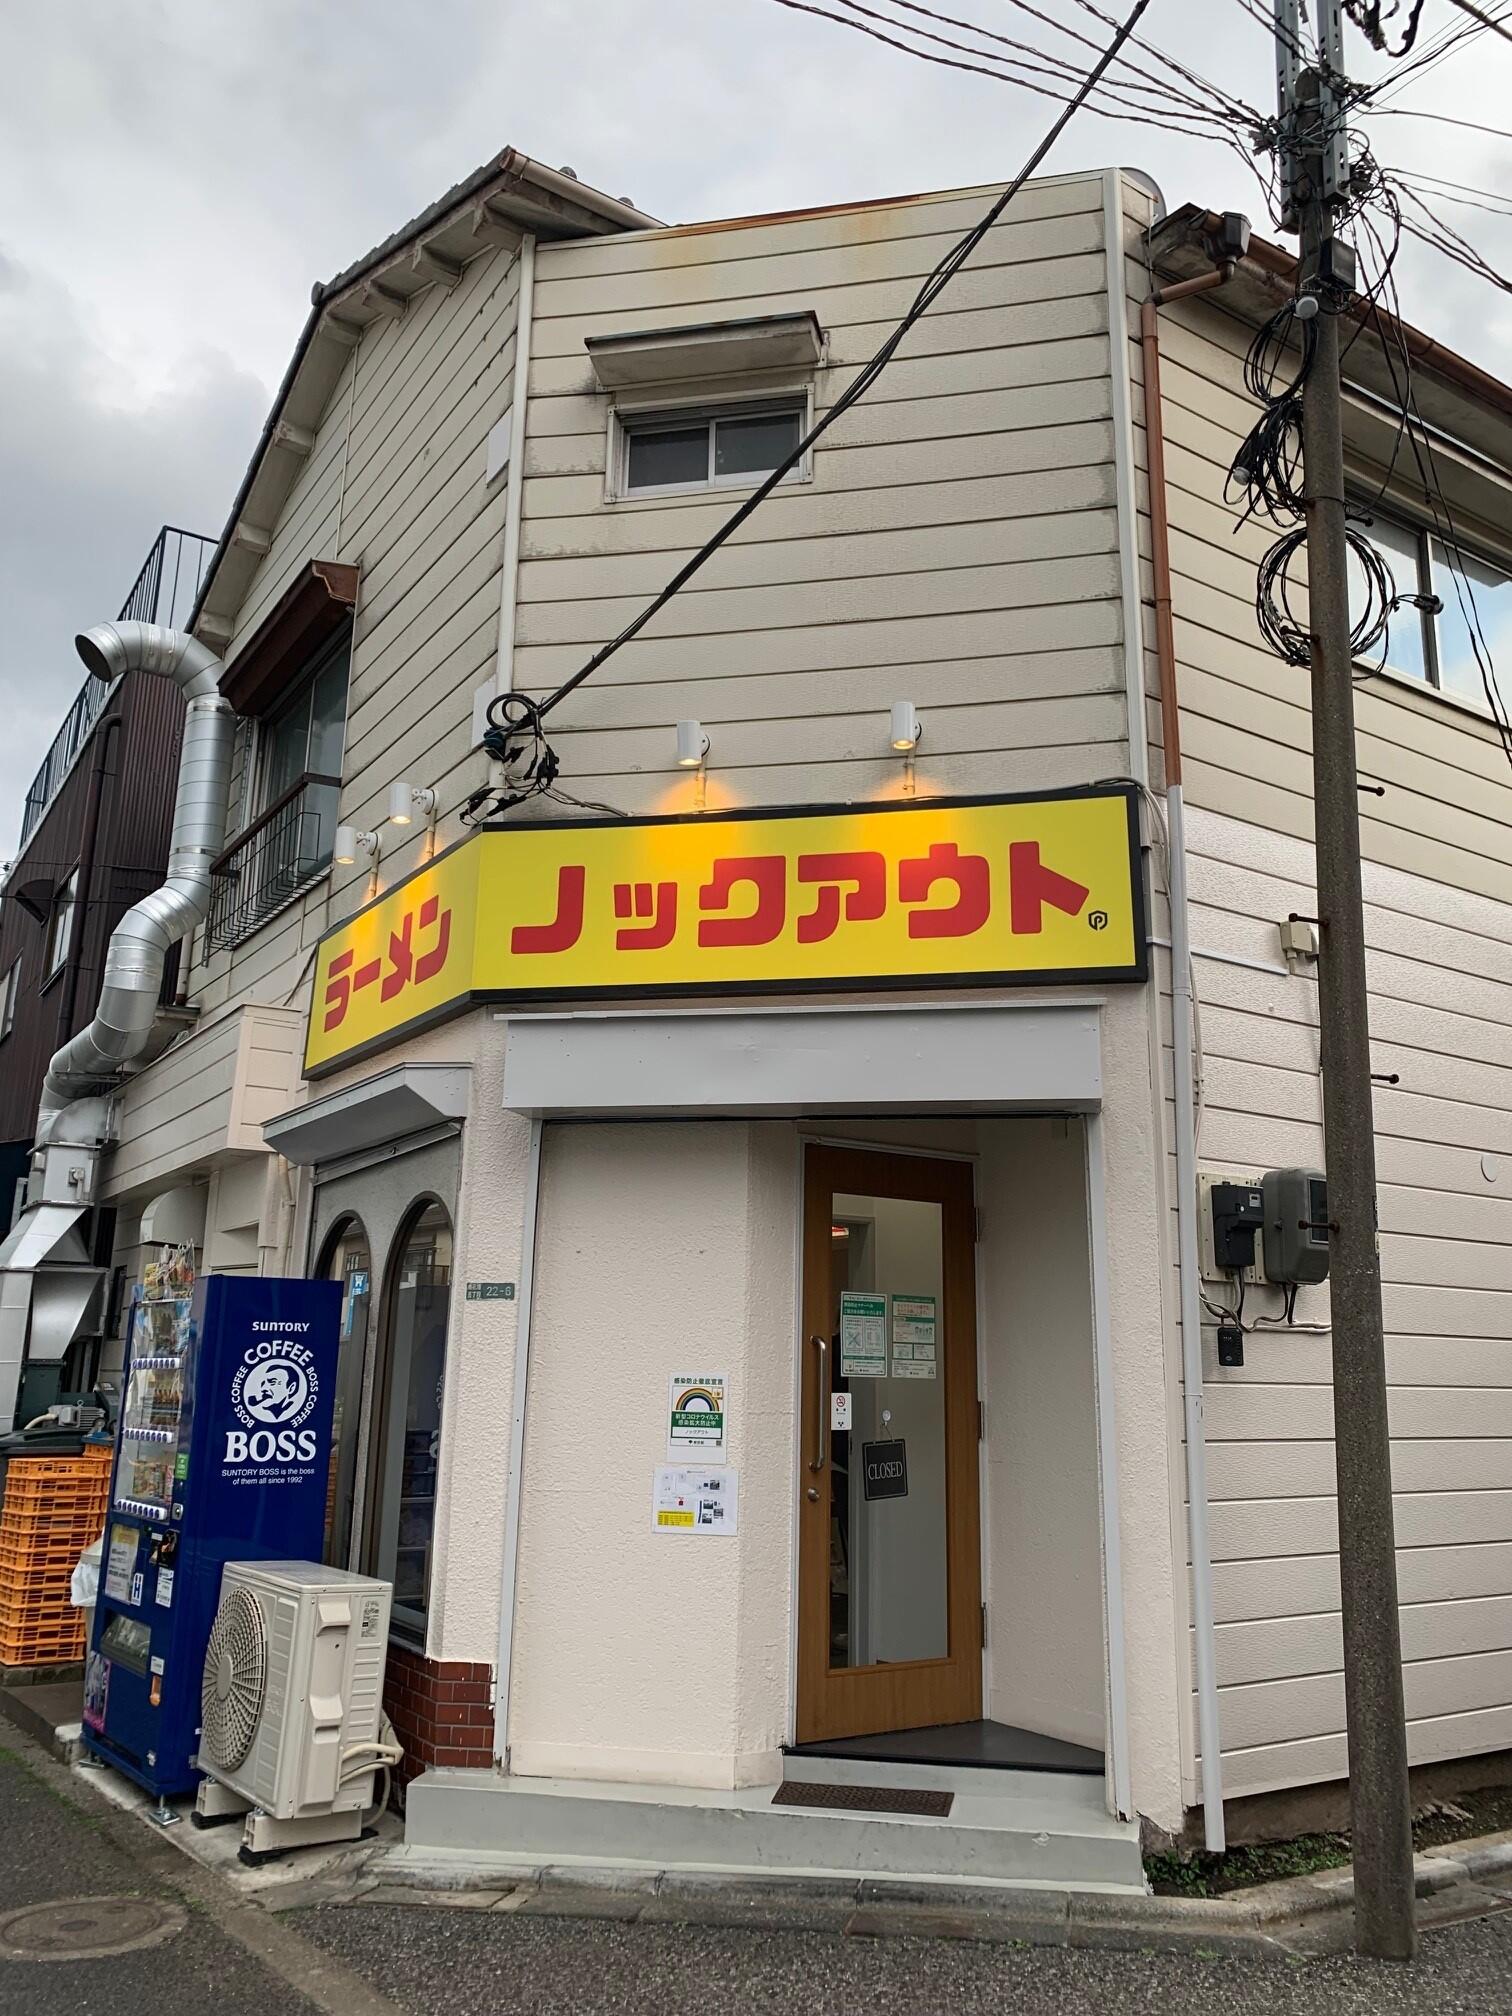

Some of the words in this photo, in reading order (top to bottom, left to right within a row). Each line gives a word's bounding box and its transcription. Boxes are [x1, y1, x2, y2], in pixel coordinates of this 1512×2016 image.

[510, 840, 1090, 955] ノックアウト
[323, 894, 452, 1032] ラーメン
[486, 1286, 512, 1297] 22-6
[252, 1321, 310, 1332] SUNTORY
[244, 1340, 314, 1366] COFFEE
[231, 1365, 249, 1403] COFFEE
[305, 1366, 319, 1392] BOSS
[234, 1405, 255, 1429] BOSS
[290, 1394, 317, 1428] COFFEE
[223, 1430, 317, 1463] BOSS
[221, 1468, 259, 1477] SUNTORY
[259, 1468, 280, 1476] BOSS
[299, 1467, 315, 1475] boss
[232, 1477, 240, 1485] of
[241, 1477, 258, 1485] them
[287, 1476, 303, 1484] 1992
[867, 1461, 903, 1481] CLOSED
